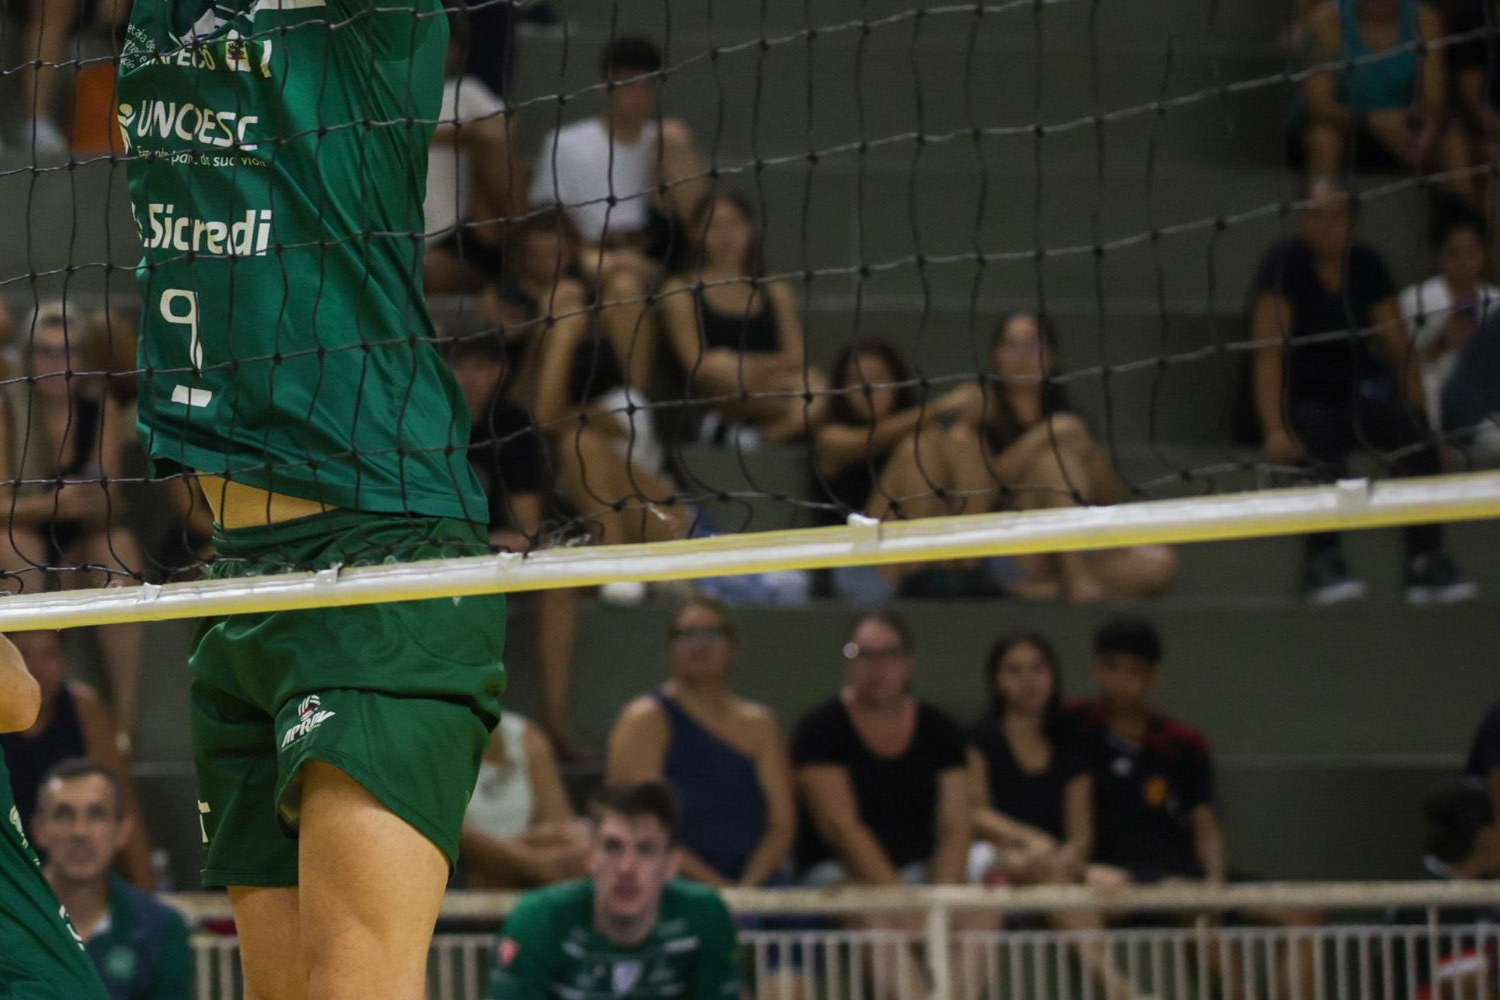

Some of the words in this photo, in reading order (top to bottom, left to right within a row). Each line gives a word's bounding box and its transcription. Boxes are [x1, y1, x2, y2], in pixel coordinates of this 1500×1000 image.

[137, 100, 259, 151] UNOESC
[143, 203, 273, 256] Sicredi
[160, 288, 204, 378] 9
